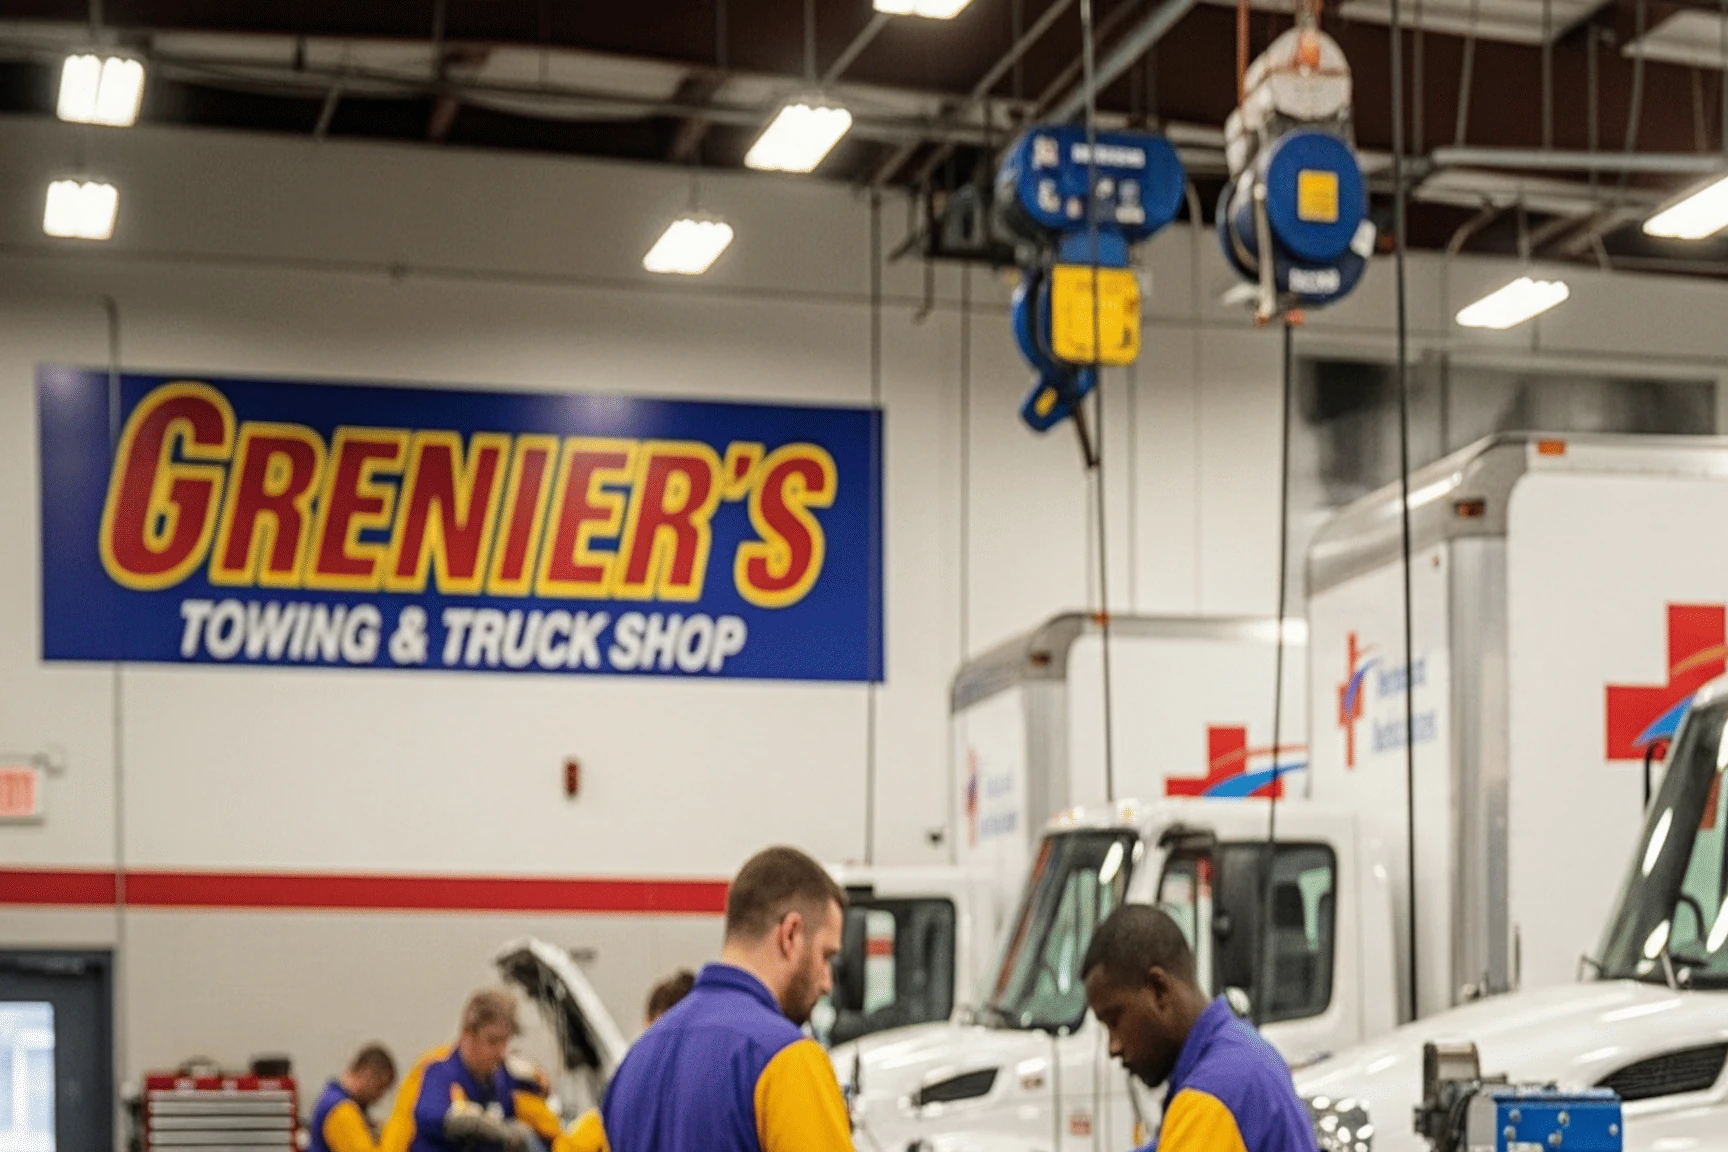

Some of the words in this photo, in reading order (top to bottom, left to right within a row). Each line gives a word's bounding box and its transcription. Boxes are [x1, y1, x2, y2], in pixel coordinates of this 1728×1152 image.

[100, 381, 838, 608] GRENIER'S
[178, 601, 380, 664] TOWING
[389, 607, 429, 665] &
[441, 609, 609, 669] TRUCK
[609, 614, 747, 673] SHOP
